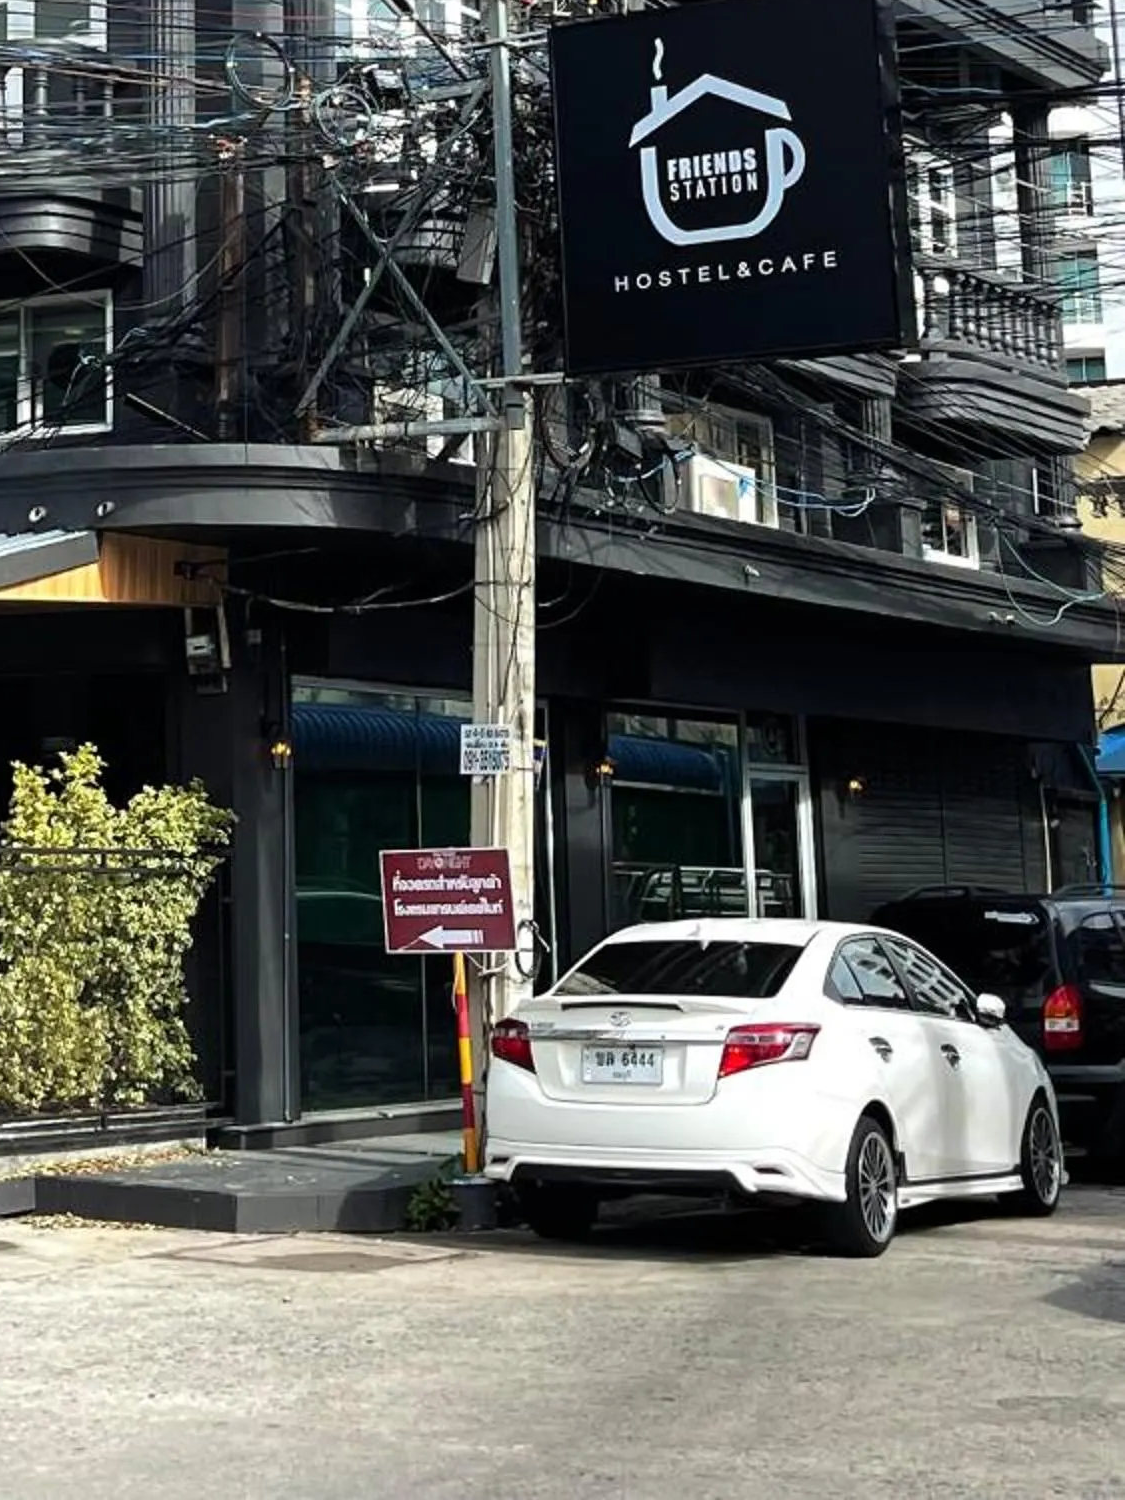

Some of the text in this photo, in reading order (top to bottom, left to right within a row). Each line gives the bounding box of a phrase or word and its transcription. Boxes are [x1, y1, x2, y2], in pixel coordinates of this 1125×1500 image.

[667, 147, 758, 181] FRIENDS
[669, 174, 759, 201] STATION
[614, 251, 839, 292] HOSTEL&CAFE
